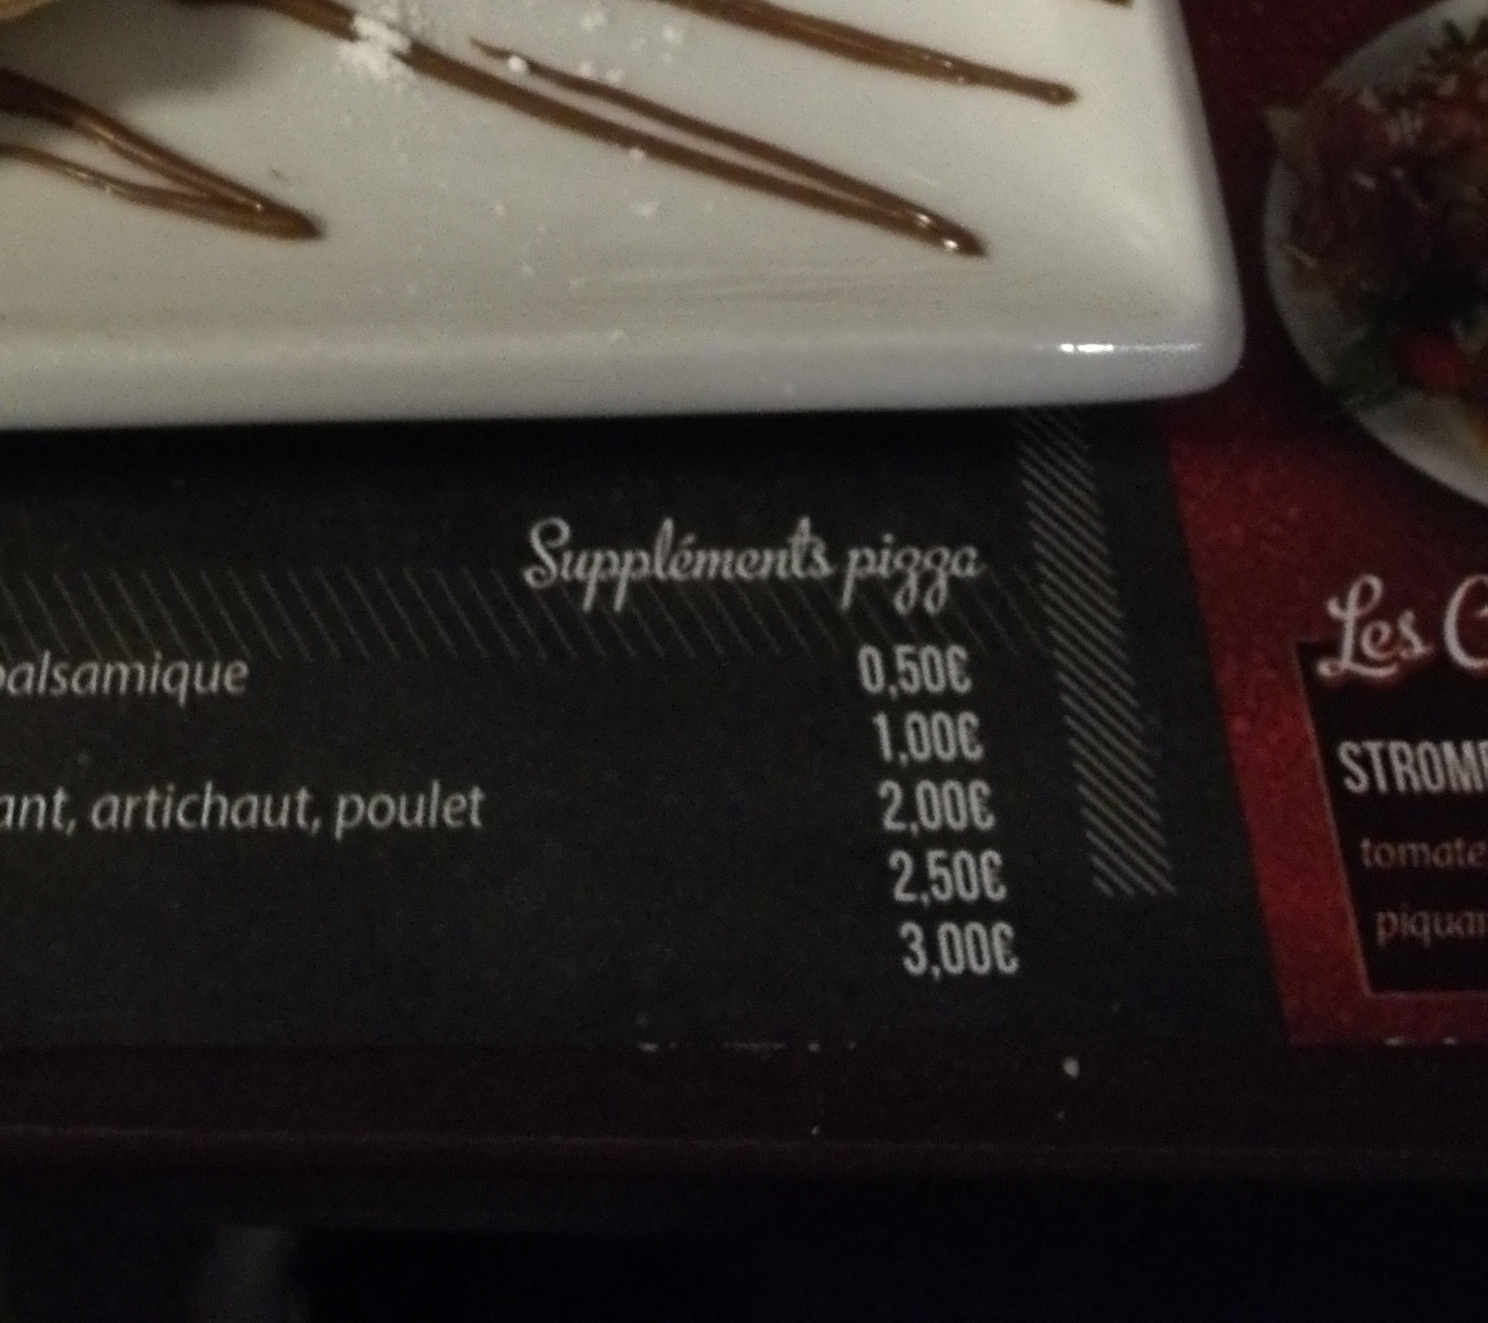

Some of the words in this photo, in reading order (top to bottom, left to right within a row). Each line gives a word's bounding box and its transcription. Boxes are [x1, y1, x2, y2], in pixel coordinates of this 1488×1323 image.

[523, 515, 837, 614] Suppléments
[839, 532, 985, 616] pizza
[1315, 572, 1434, 681] Les
[856, 643, 973, 701] 0,50€
[872, 710, 986, 769] 1,00€
[89, 781, 323, 835] artichaut,
[334, 779, 487, 841] poulet
[877, 778, 997, 836] 2,00€
[888, 849, 1009, 909] 2,50€
[898, 920, 1020, 982] 3,00€
